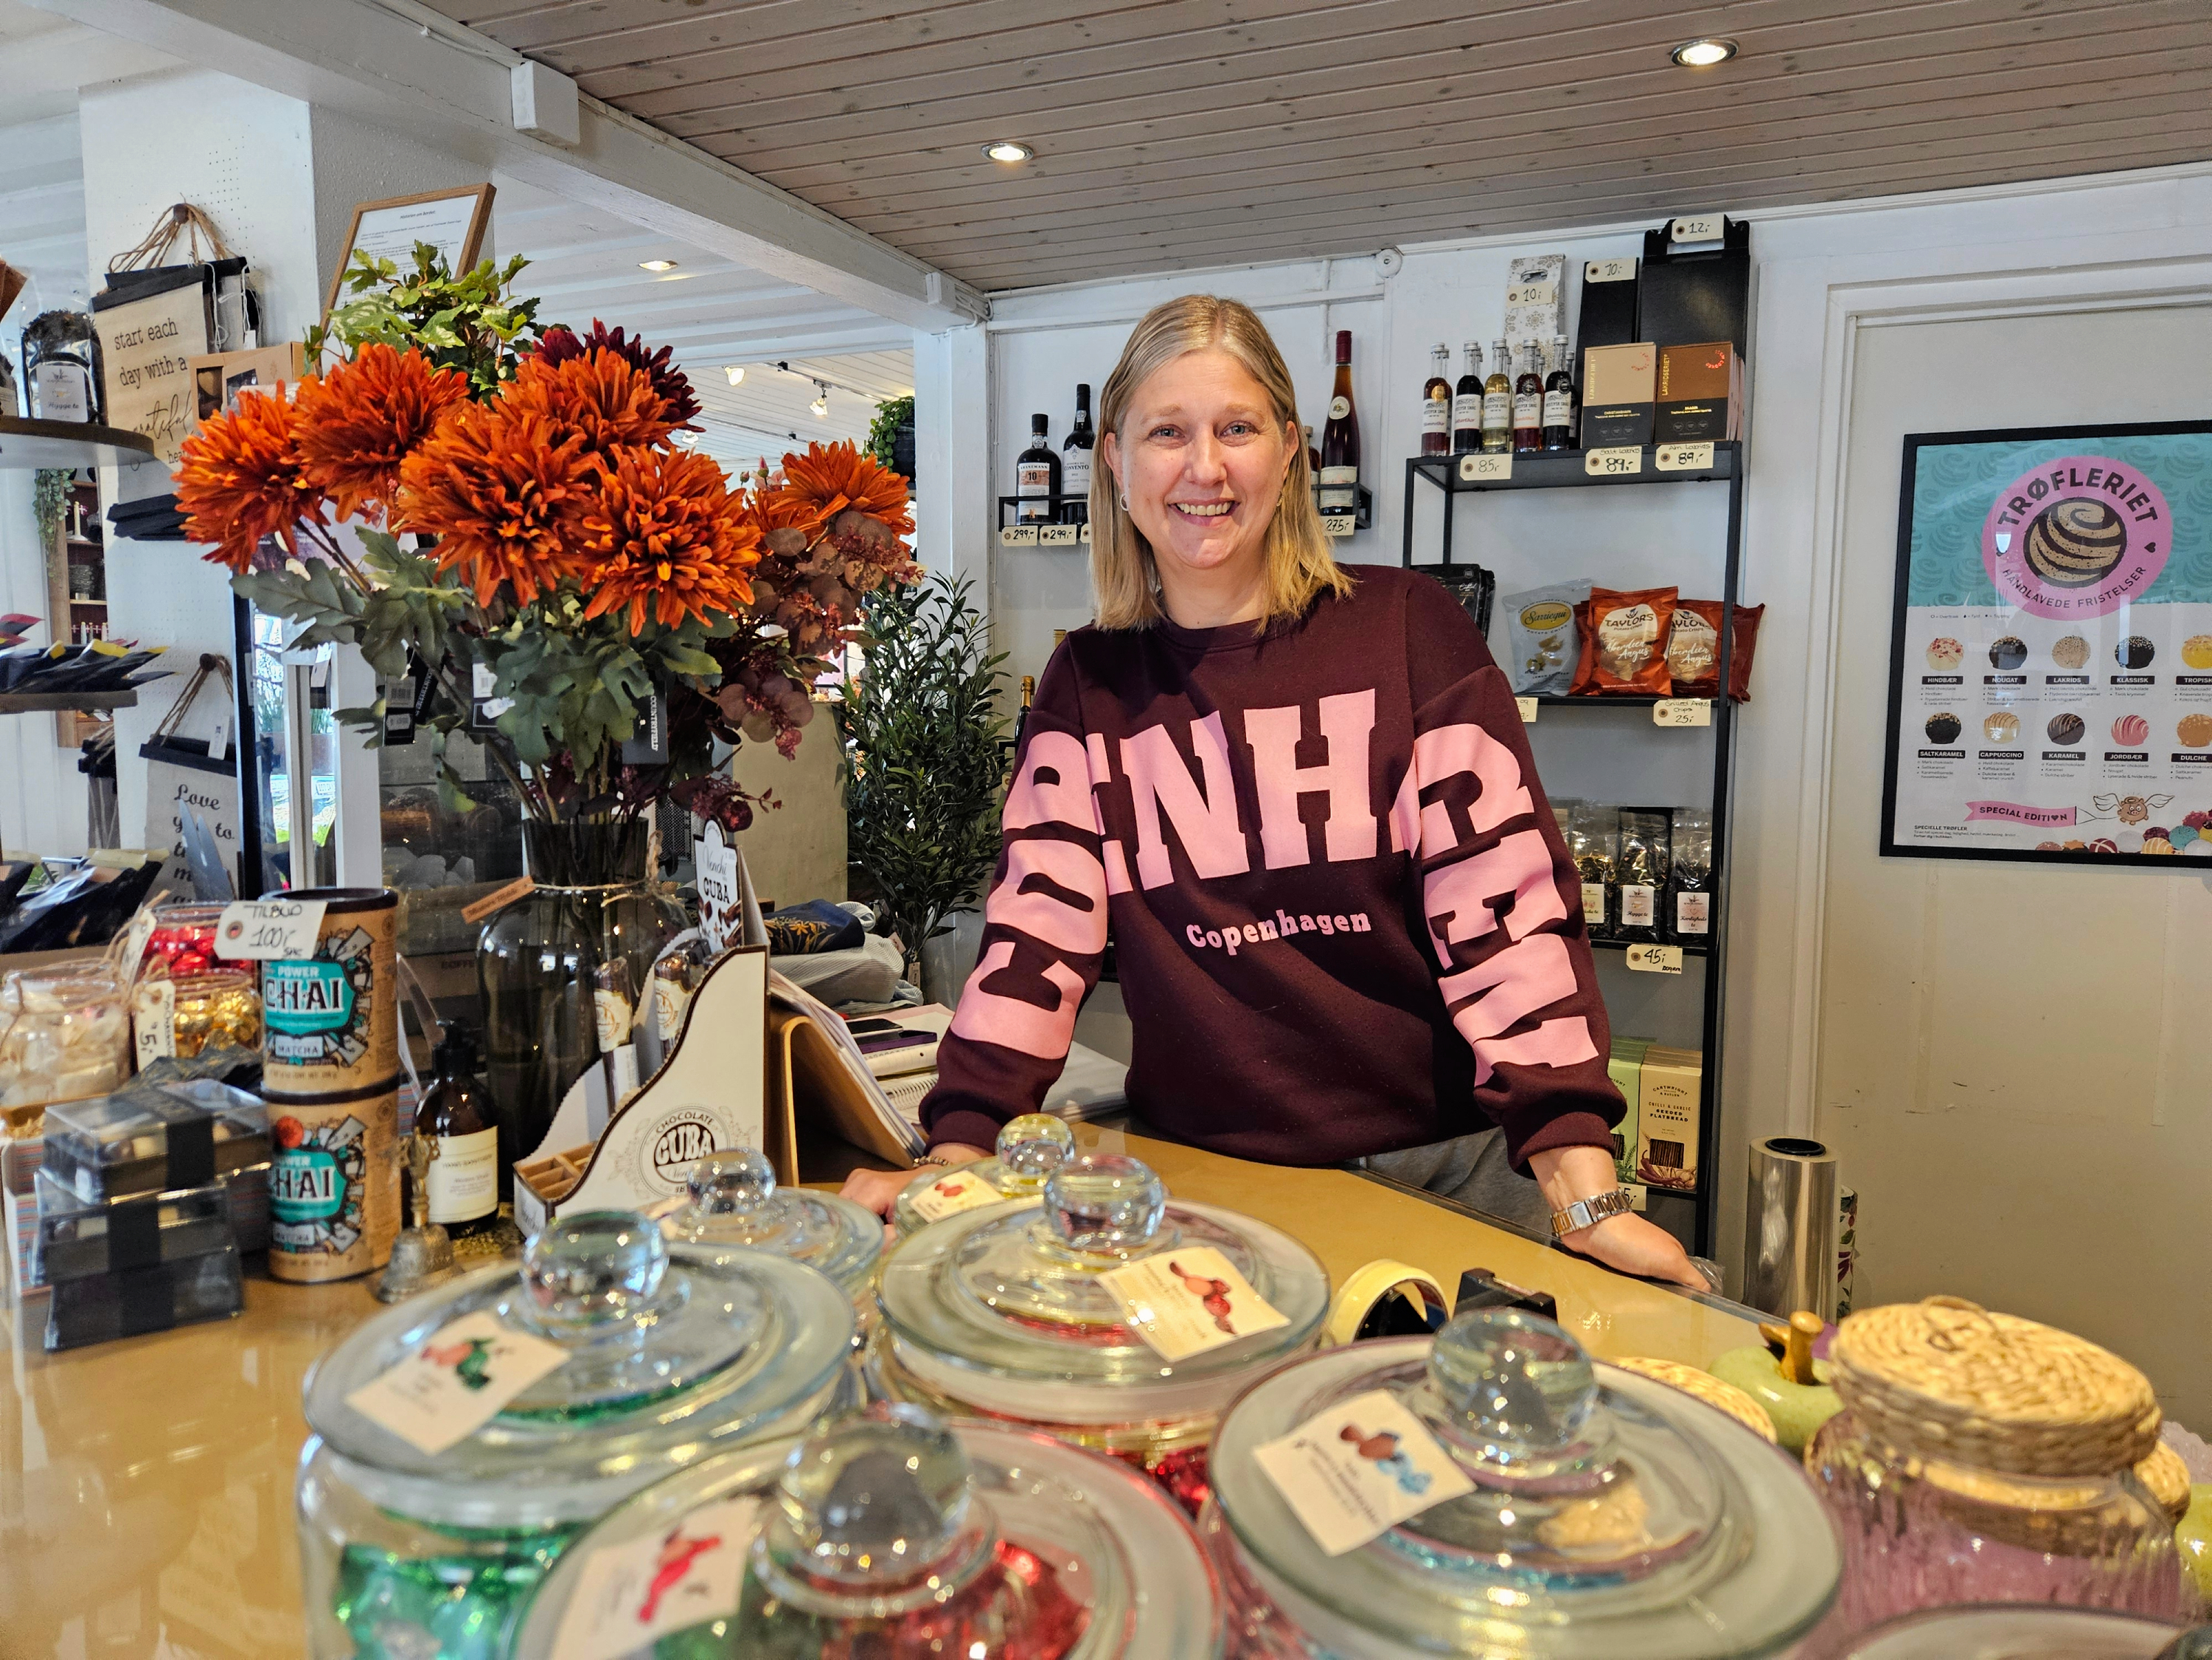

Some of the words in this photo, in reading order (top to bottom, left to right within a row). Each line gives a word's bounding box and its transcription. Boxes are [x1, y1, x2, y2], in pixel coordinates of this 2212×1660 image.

[114, 327, 144, 350] start
[147, 318, 178, 341] each
[119, 367, 141, 389] day
[145, 355, 174, 380] with
[178, 357, 187, 371] a
[167, 449, 184, 465] hea
[1028, 472, 1037, 481] 10
[1997, 468, 2158, 525] TRØFLERIET
[2002, 569, 2070, 608] HÅNDLAVEDE
[2078, 566, 2146, 608] FRISTELSER
[1524, 608, 1568, 625] Sarriegui
[1605, 614, 1654, 627] TAYLORS
[1550, 624, 1568, 633] CHIPS
[1604, 639, 1646, 653] Aberdeen
[1618, 647, 1649, 663] Angus
[1680, 653, 1712, 667] Angus
[1691, 700, 1710, 709] Angus
[173, 783, 220, 810] Love
[1980, 806, 2021, 818] SPECIAL
[703, 877, 731, 904] CUBA
[243, 904, 302, 919] TILBUD
[1186, 909, 1371, 956] Copenhagen
[277, 965, 320, 977] POWER
[265, 978, 344, 1013] CHAI
[277, 1045, 319, 1055] MATCHA
[1652, 1085, 1688, 1096] CARTWRIGHT
[655, 1111, 714, 1134] CHOCOLATE
[1649, 1113, 1688, 1122] FLATBREAD
[655, 1124, 713, 1165] CUBA
[667, 1165, 689, 1180] Ven
[270, 1167, 335, 1201] HAI
